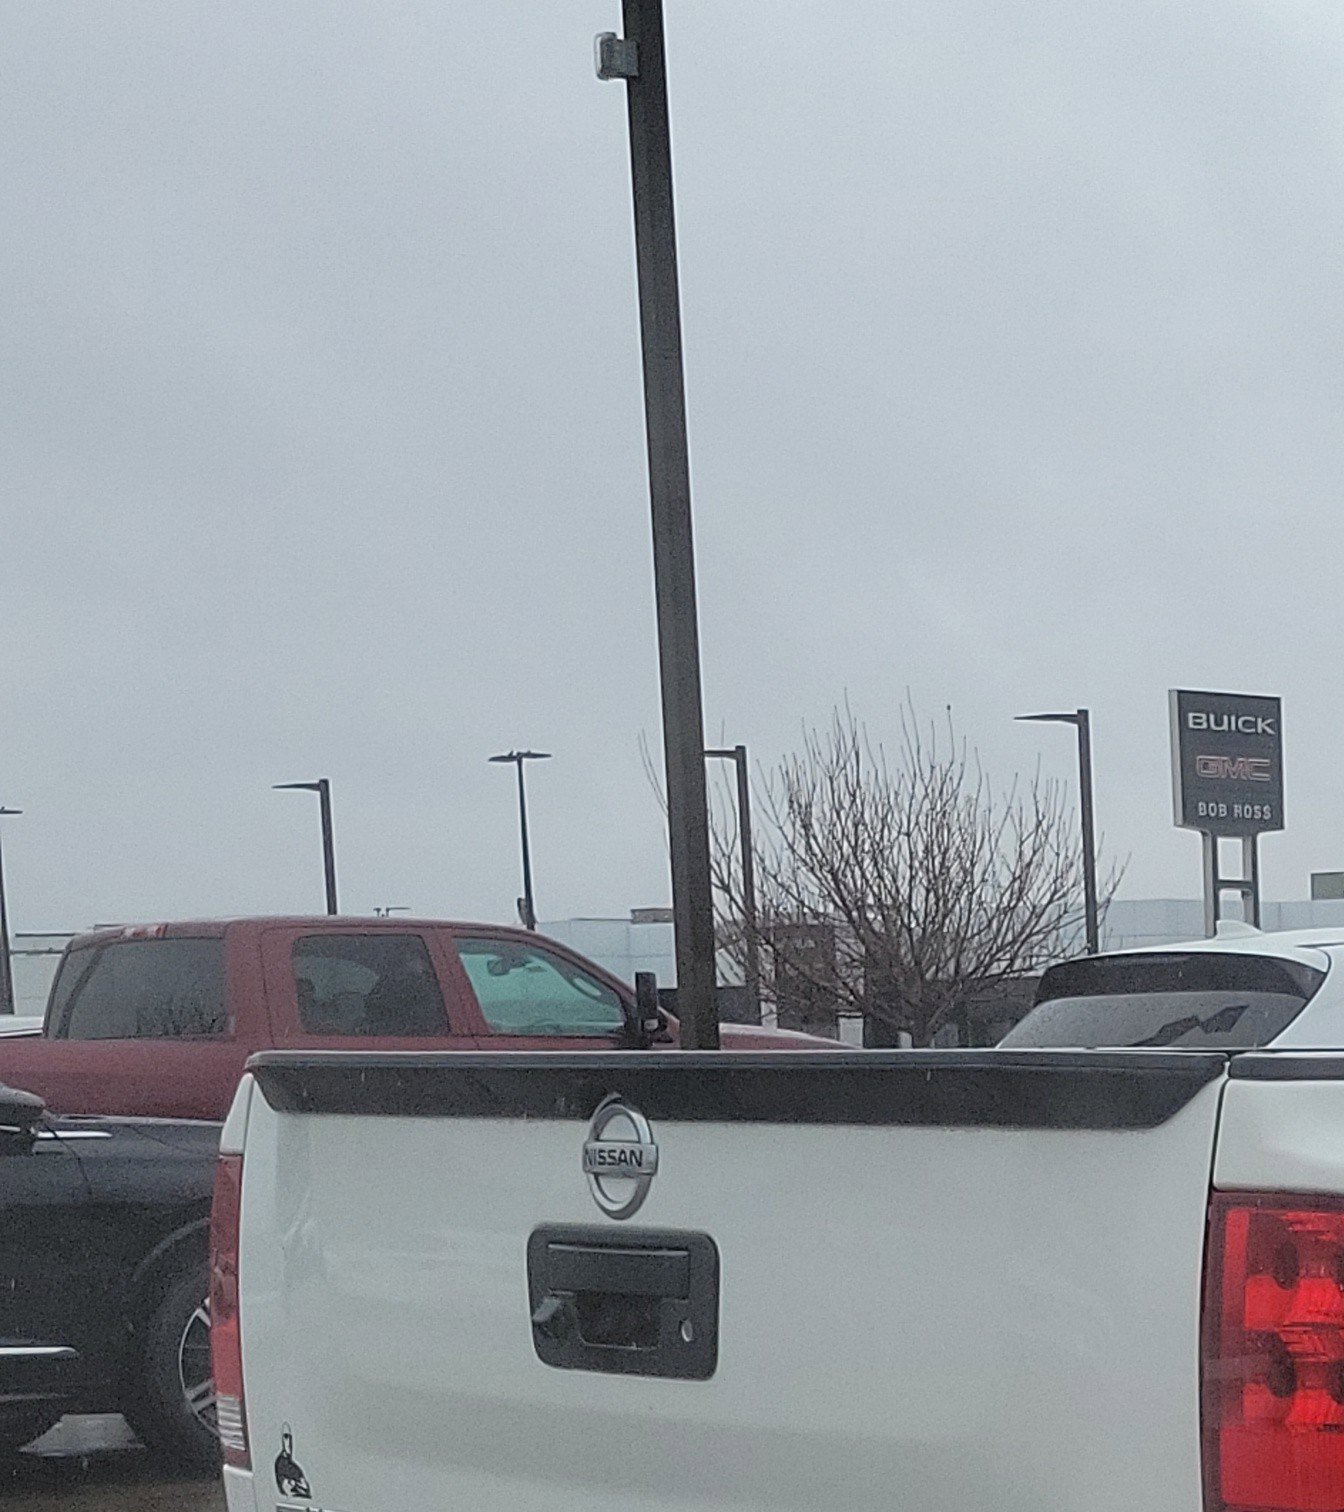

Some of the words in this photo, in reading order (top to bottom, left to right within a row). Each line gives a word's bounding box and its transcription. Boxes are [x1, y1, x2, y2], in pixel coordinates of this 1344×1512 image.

[1187, 712, 1275, 735] BUICK
[1196, 755, 1271, 782] GMC
[1198, 802, 1227, 817] BOB
[1234, 804, 1271, 820] ROSS
[586, 1148, 644, 1168] NISSAN
